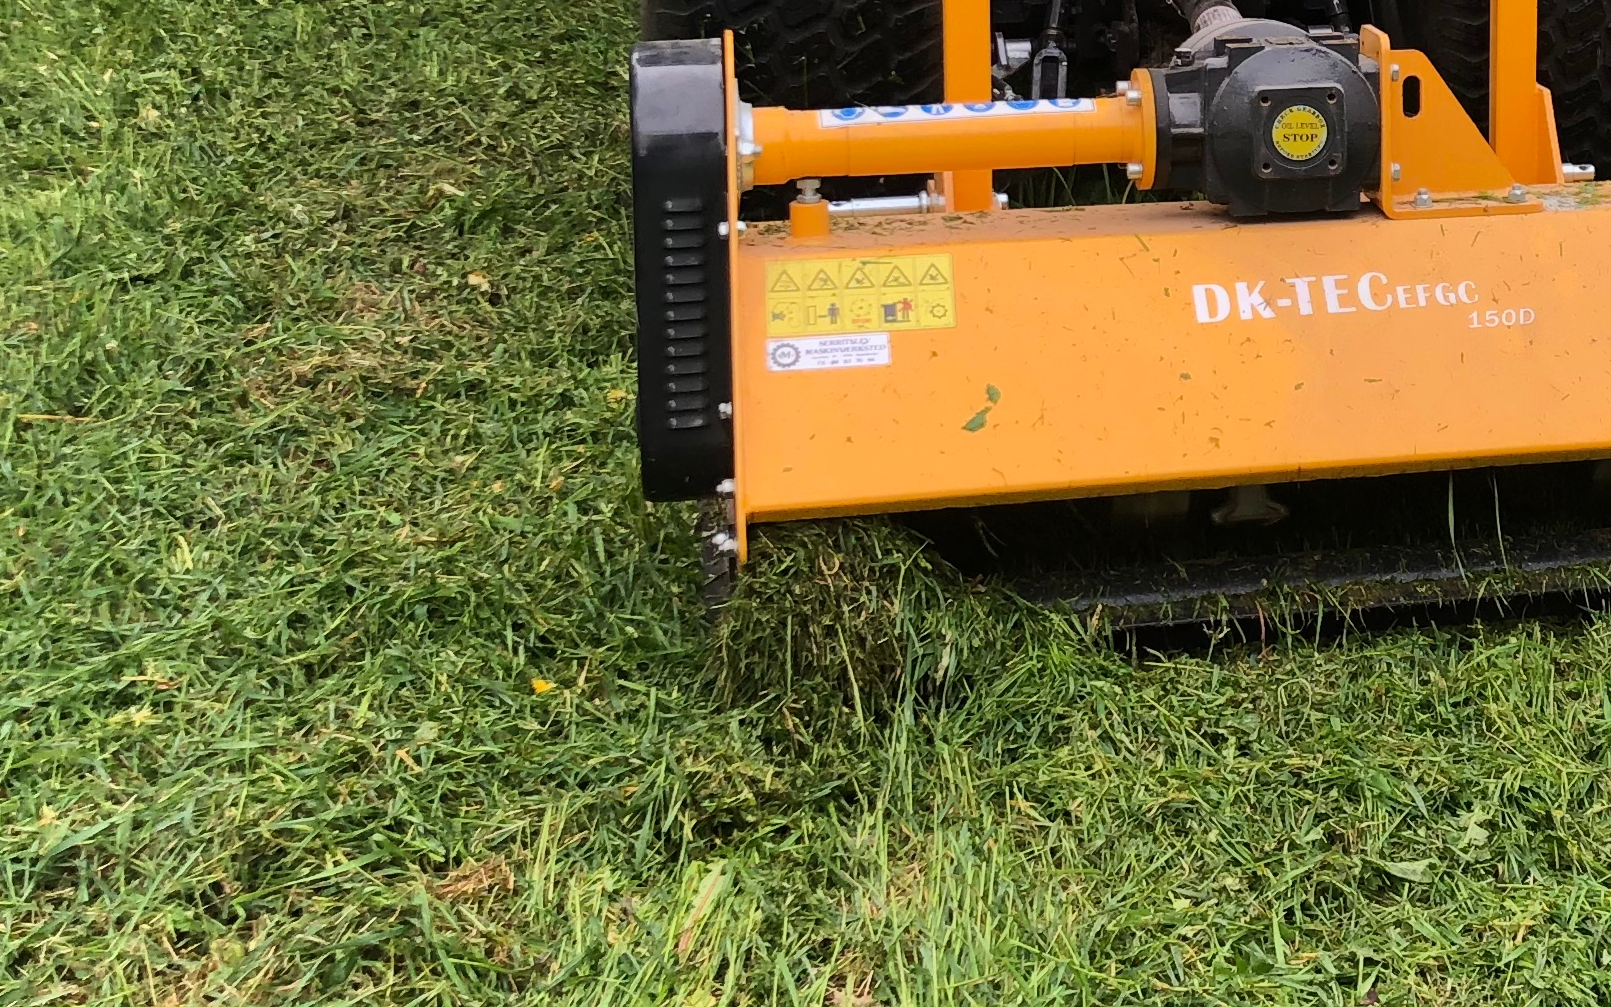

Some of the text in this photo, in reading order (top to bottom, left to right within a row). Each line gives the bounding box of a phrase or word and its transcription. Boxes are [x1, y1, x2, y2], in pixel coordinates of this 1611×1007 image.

[1282, 133, 1318, 142] STOP
[1191, 271, 1393, 324] DK-TEC
[1467, 307, 1536, 329] 150D
